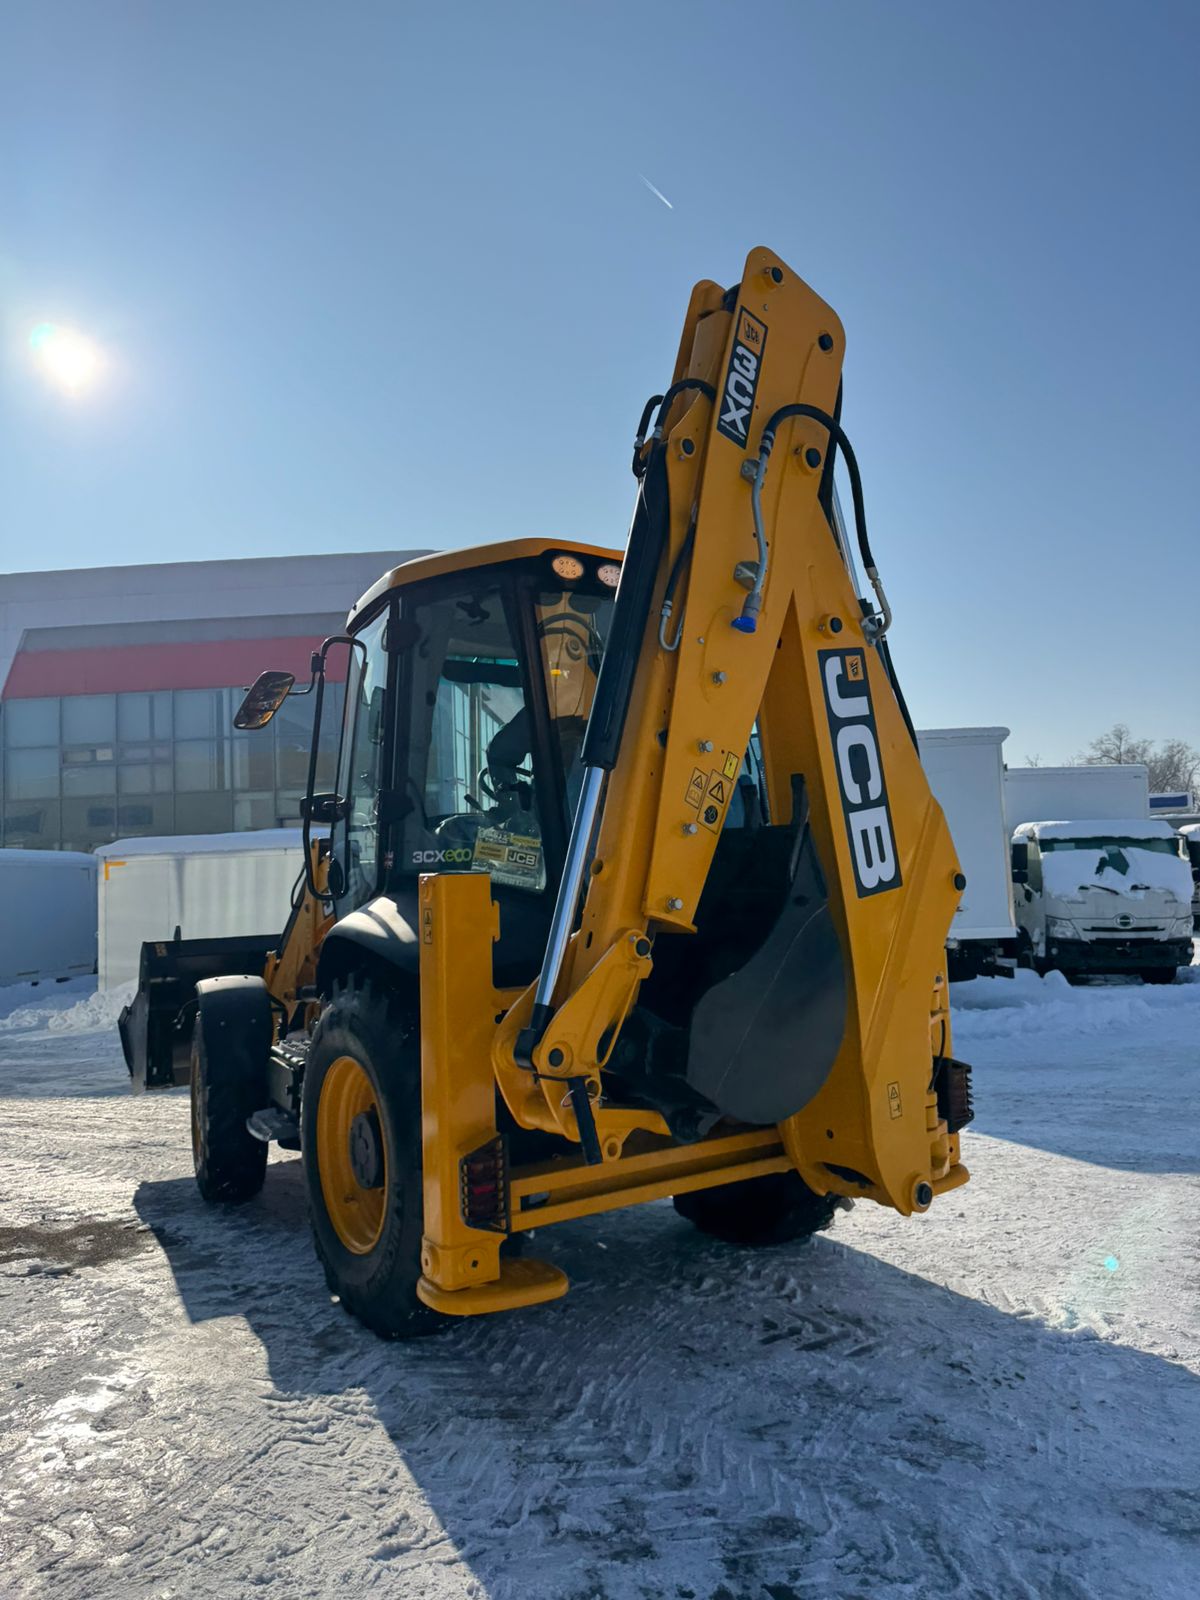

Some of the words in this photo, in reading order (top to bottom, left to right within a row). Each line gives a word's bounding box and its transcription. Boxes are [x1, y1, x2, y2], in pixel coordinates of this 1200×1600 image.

[720, 345, 758, 436] 3CX
[825, 656, 896, 889] JCB
[508, 850, 536, 866] JCB
